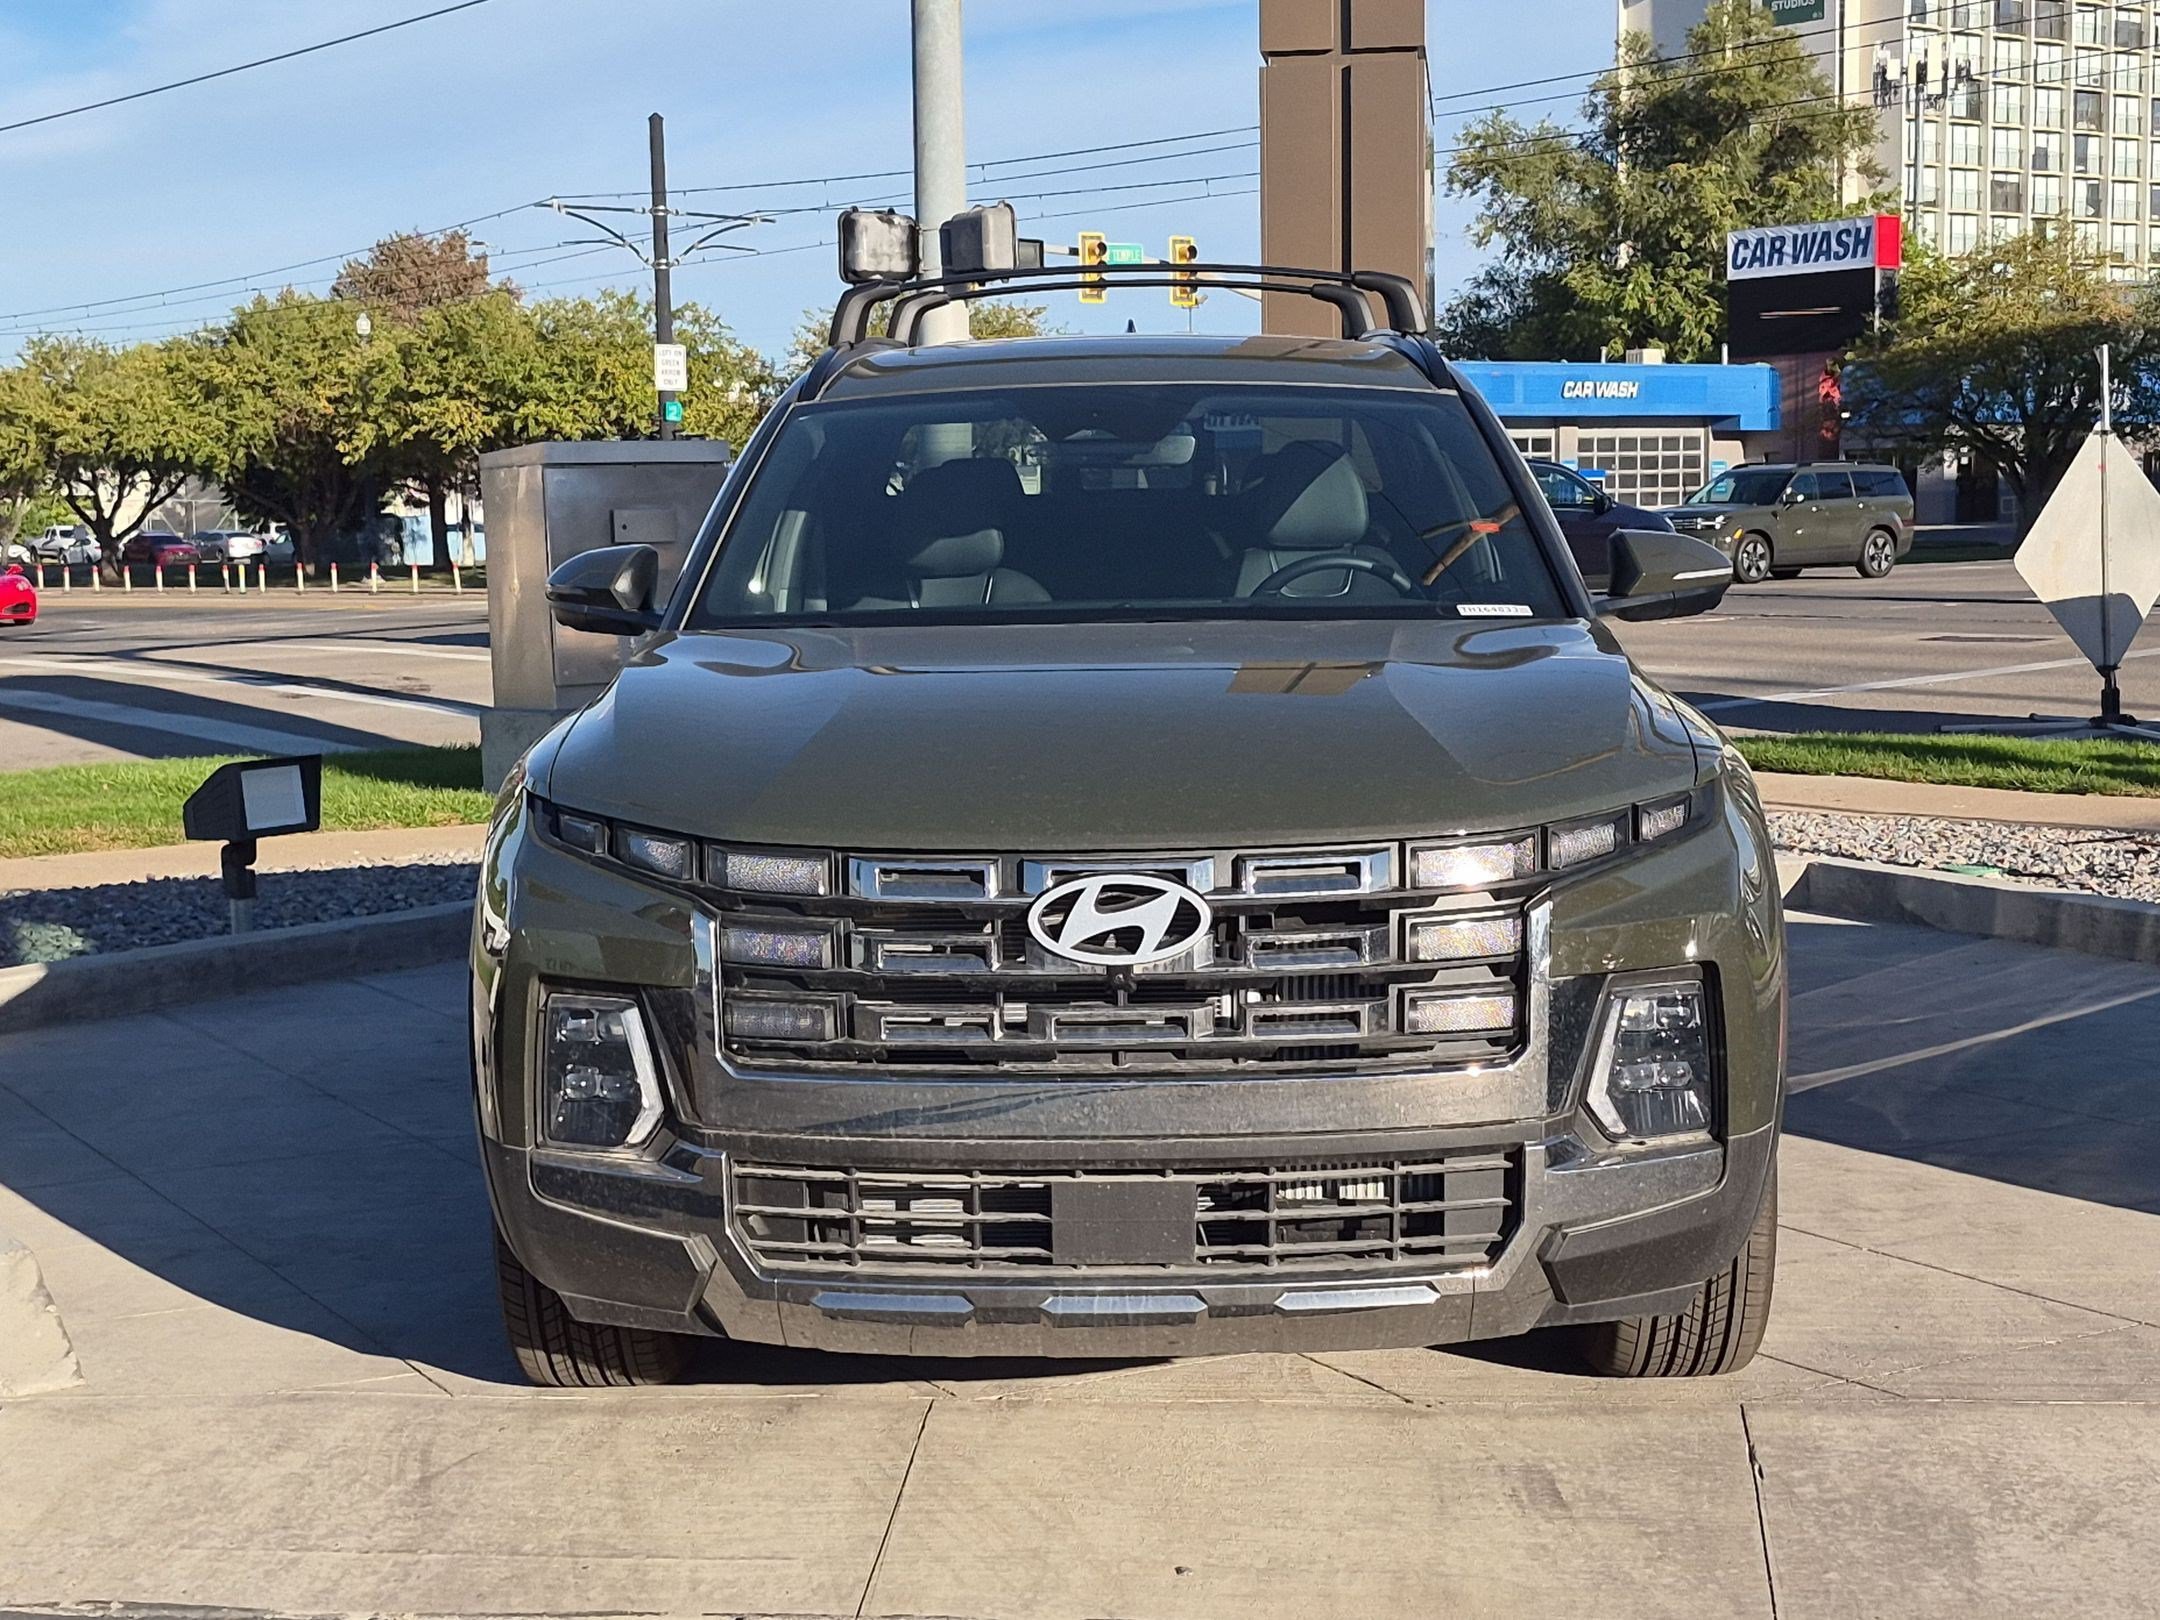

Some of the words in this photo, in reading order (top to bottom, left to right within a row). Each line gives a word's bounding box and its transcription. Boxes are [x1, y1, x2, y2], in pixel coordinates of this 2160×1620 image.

[1731, 234, 1787, 270] CAR
[1791, 226, 1873, 265] WASH
[1562, 380, 1594, 399] CAR
[1595, 380, 1639, 399] WASH
